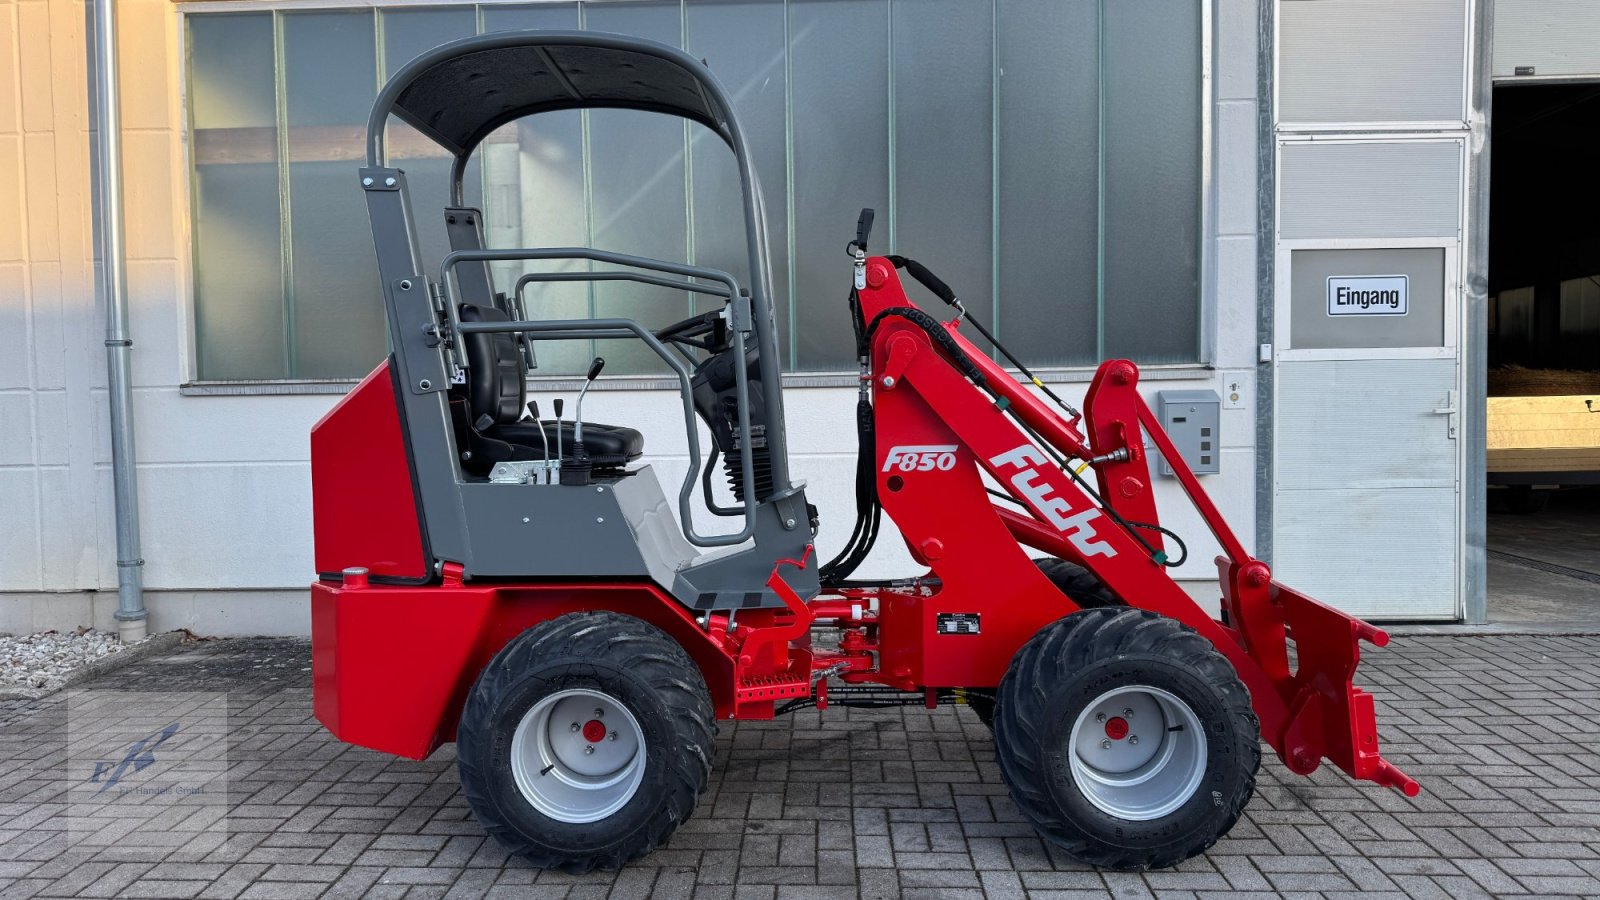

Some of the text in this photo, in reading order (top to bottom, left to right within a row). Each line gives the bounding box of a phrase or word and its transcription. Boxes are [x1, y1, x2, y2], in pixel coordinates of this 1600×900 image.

[1336, 287, 1399, 309] Eingang
[881, 445, 959, 473] F850
[989, 444, 1118, 558] Fuchs
